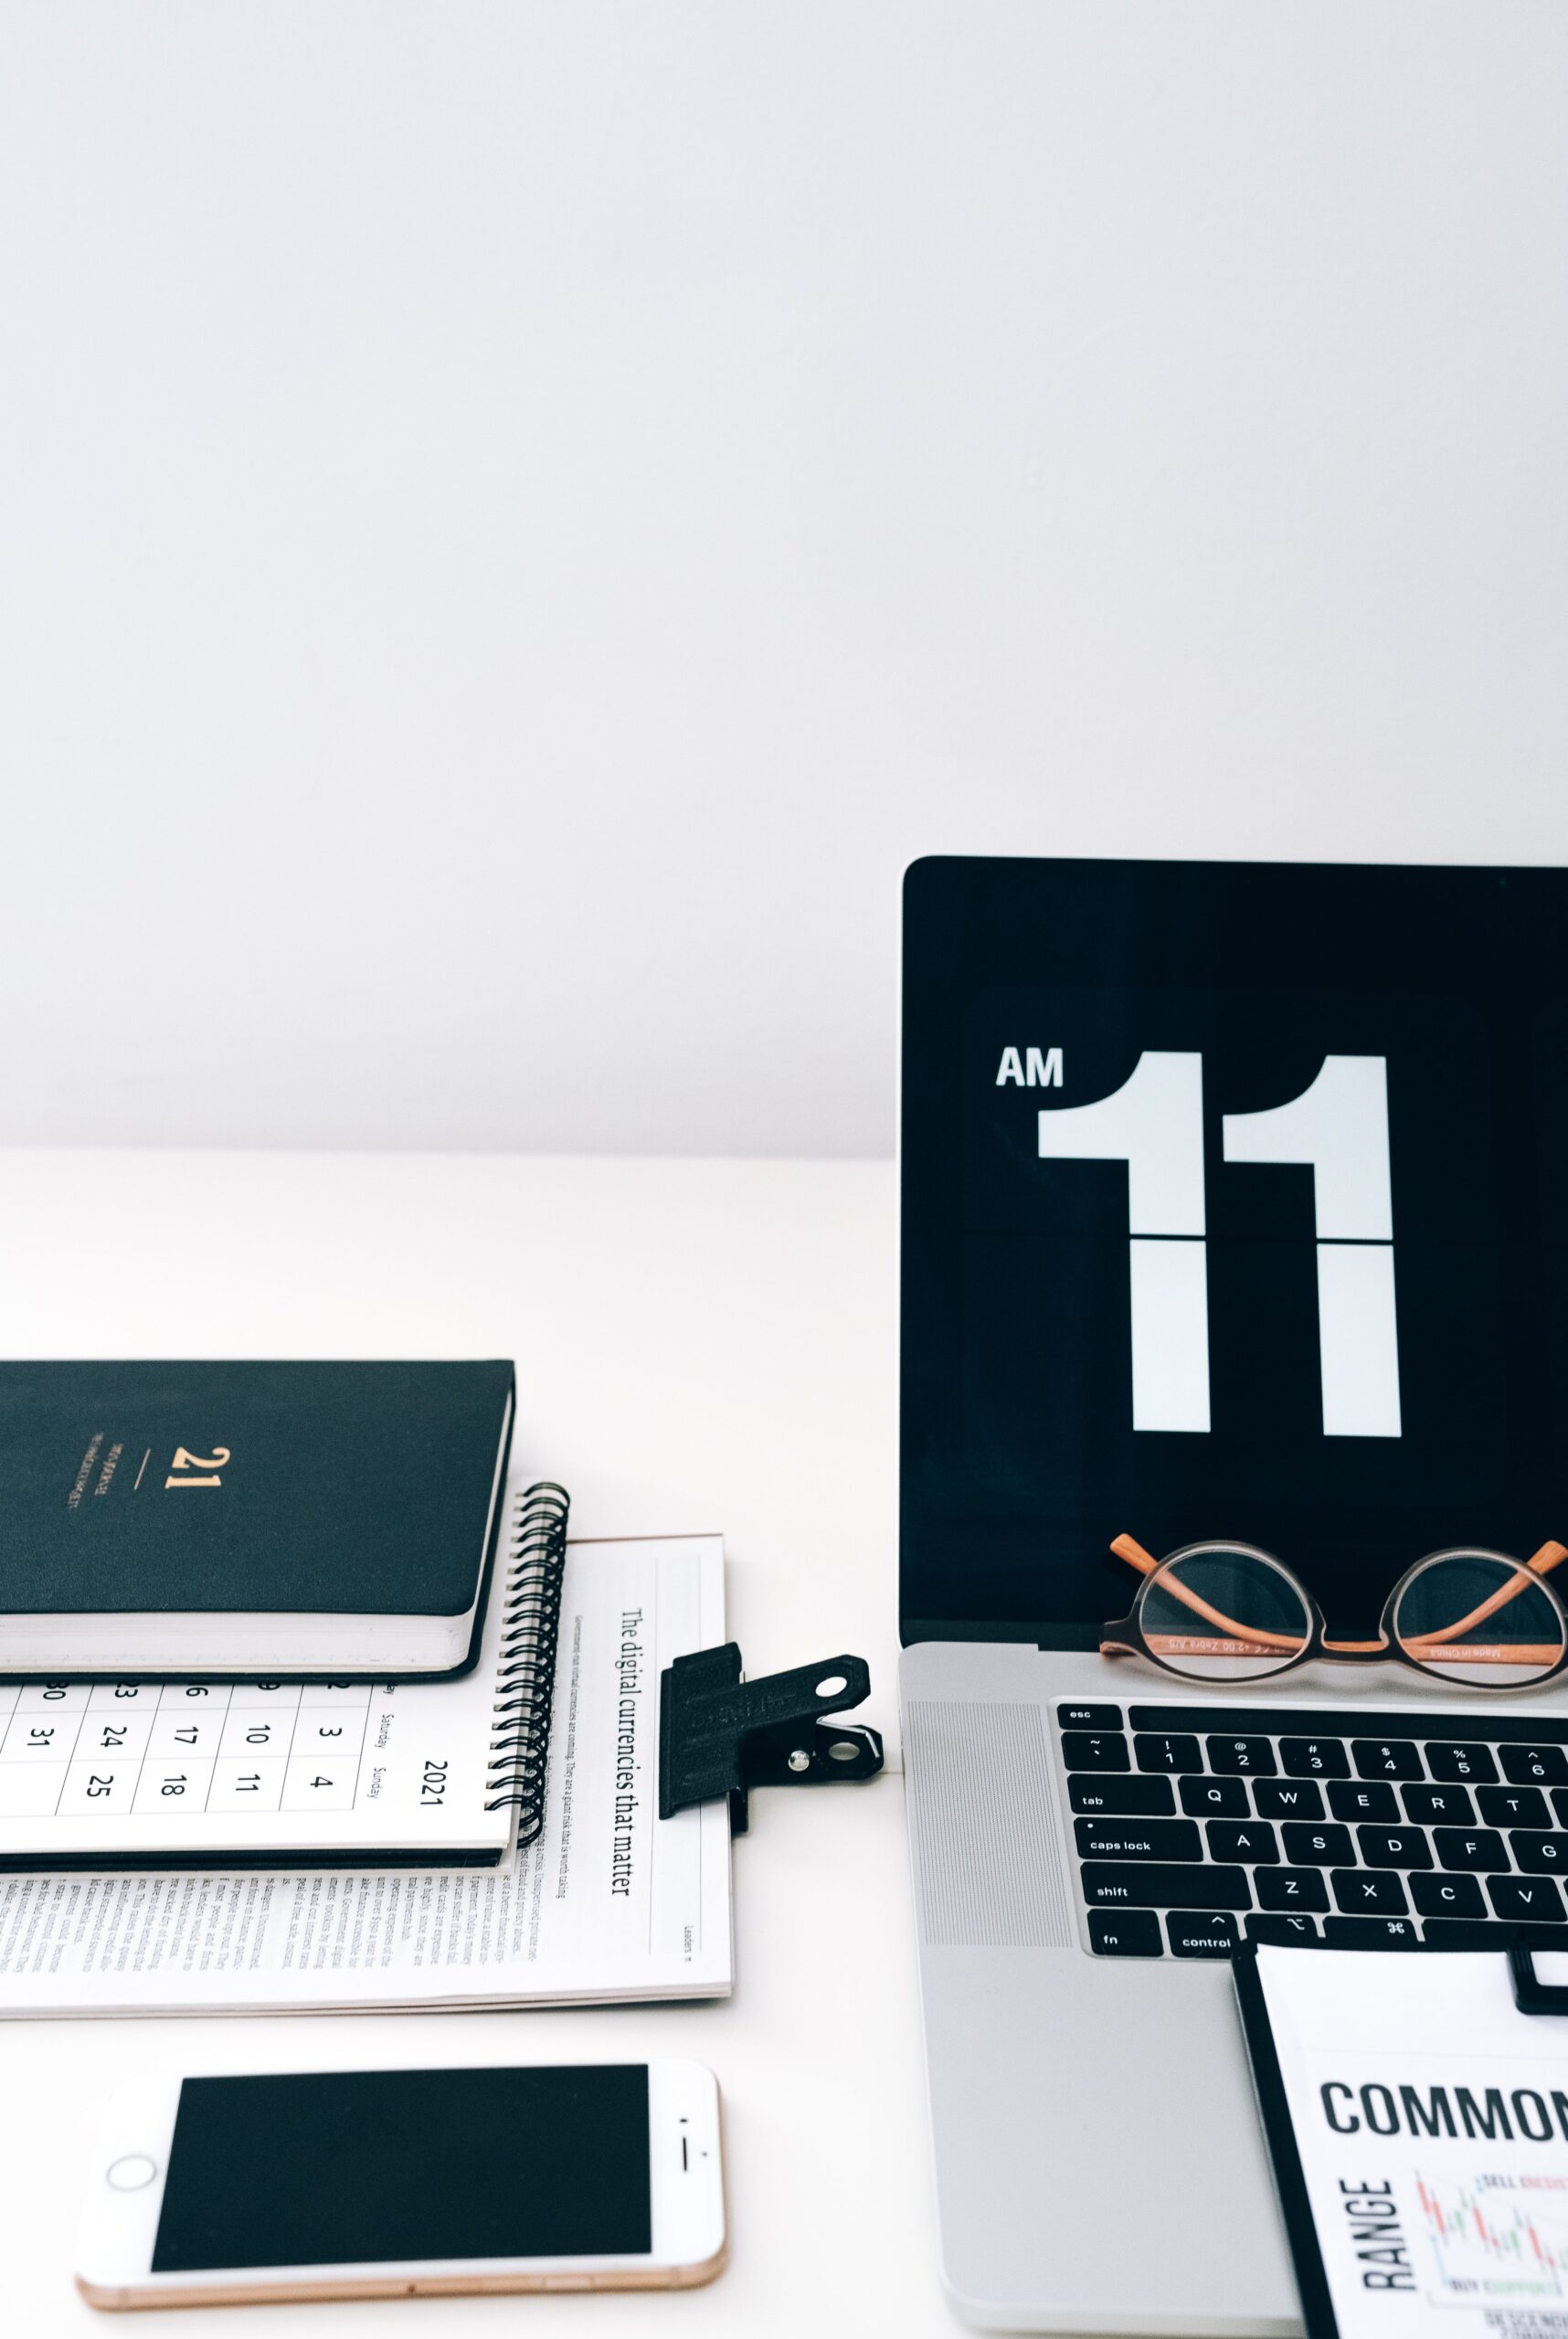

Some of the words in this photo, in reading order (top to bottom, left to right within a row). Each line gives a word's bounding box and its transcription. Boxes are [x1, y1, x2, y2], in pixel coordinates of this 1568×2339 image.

[996, 1047, 1063, 1086] AM
[1038, 1052, 1402, 1437] 11
[164, 1446, 230, 1489] 21
[621, 1609, 642, 1637] The
[572, 1615, 584, 1666] Government-run
[1190, 1639, 1219, 1651] Zebra
[1430, 1648, 1459, 1658] China
[1462, 1648, 1471, 1656] in
[1472, 1649, 1500, 1658] Made
[615, 1642, 643, 1695] digital
[571, 1667, 580, 1688] virtual
[568, 1688, 578, 1720] currencies
[27, 1729, 55, 1746] 31
[101, 1727, 127, 1747] 24
[175, 1726, 199, 1744] 17
[246, 1725, 270, 1743] 10
[319, 1728, 343, 1737] 3
[375, 1715, 394, 1749] Saturday
[565, 1734, 577, 1761] coming.
[616, 1699, 641, 1789] currencies
[1234, 1742, 1246, 1751] @
[1308, 1745, 1317, 1753] #
[1382, 1747, 1390, 1756] $
[1453, 1750, 1466, 1758] %
[1166, 1753, 1173, 1763] 1
[1238, 1755, 1249, 1765] 2
[1311, 1757, 1322, 1768] 3
[564, 1762, 576, 1778] They
[1384, 1760, 1396, 1770] 4
[1458, 1762, 1470, 1773] 5
[1531, 1765, 1544, 1775] 6
[87, 1775, 114, 1797] 25
[162, 1775, 187, 1795] 18
[236, 1773, 260, 1791] 11
[310, 1776, 334, 1787] 4
[367, 1767, 386, 1799] Sunday
[420, 1762, 448, 1805] 2021
[1083, 1796, 1103, 1805] tab
[1208, 1790, 1222, 1802] Q
[1279, 1793, 1298, 1804] W
[1358, 1794, 1370, 1805] E
[562, 1796, 574, 1814] giant
[1432, 1797, 1445, 1808] R
[1507, 1800, 1519, 1811] T
[614, 1795, 639, 1832] that
[562, 1815, 573, 1829] risk
[562, 1831, 572, 1845] that
[1237, 1835, 1250, 1847] A
[1313, 1837, 1326, 1848] S
[1090, 1841, 1120, 1850] caps
[1124, 1842, 1150, 1850] lock
[1388, 1839, 1402, 1851] D
[1466, 1843, 1477, 1854] F
[1542, 1846, 1556, 1857] G
[559, 1854, 569, 1874] worth
[612, 1836, 634, 1896] matter
[556, 1876, 568, 1899] taking
[1097, 1888, 1128, 1897] shift
[1285, 1882, 1298, 1894] Z
[1362, 1885, 1377, 1897] X
[531, 1873, 544, 1921] Unsupervised
[1441, 1888, 1455, 1900] C
[1519, 1890, 1531, 1903] V
[1103, 1935, 1118, 1944] fn
[1182, 1938, 1230, 1948] control
[1339, 2178, 1416, 2290] RANGE
